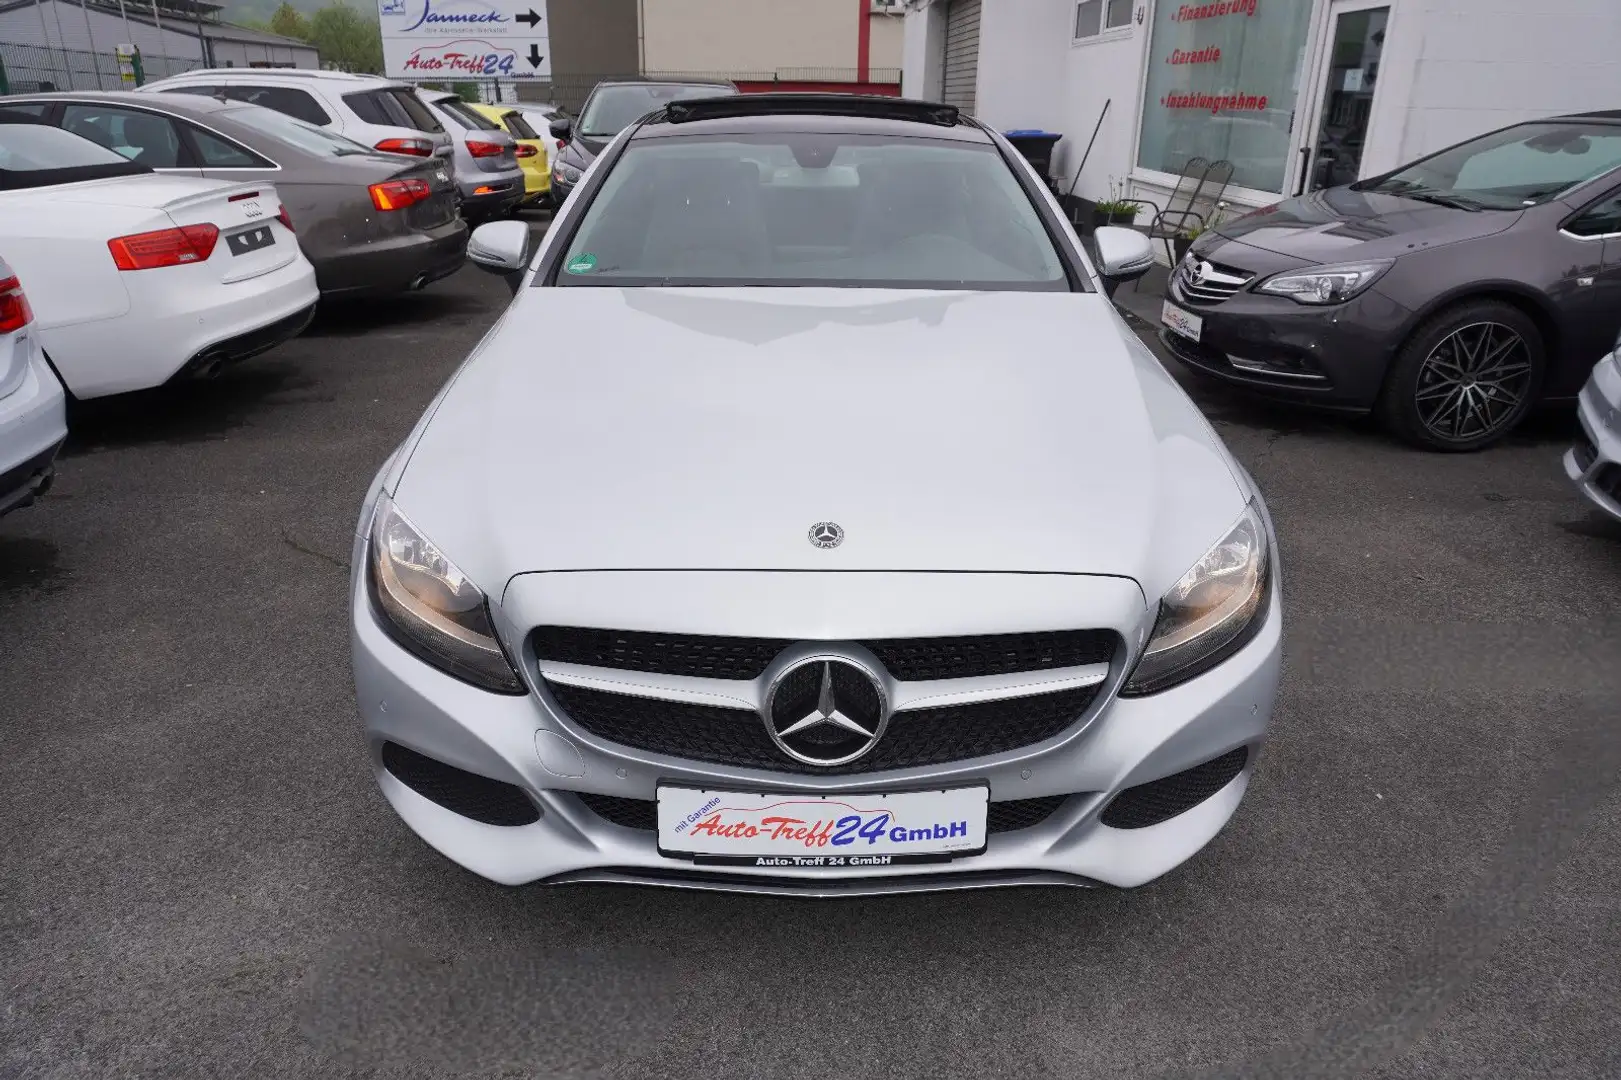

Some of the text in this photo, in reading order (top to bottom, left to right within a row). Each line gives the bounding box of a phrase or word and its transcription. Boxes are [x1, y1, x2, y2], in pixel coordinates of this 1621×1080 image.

[1177, 0, 1257, 21] Finanzierung
[1172, 45, 1221, 64] Garantie
[1166, 91, 1267, 114] Inzahlungnahme
[674, 796, 721, 834] mit Garantie
[889, 821, 967, 842] GmbH
[756, 856, 892, 866] Auto-Treff 24 GmbH
